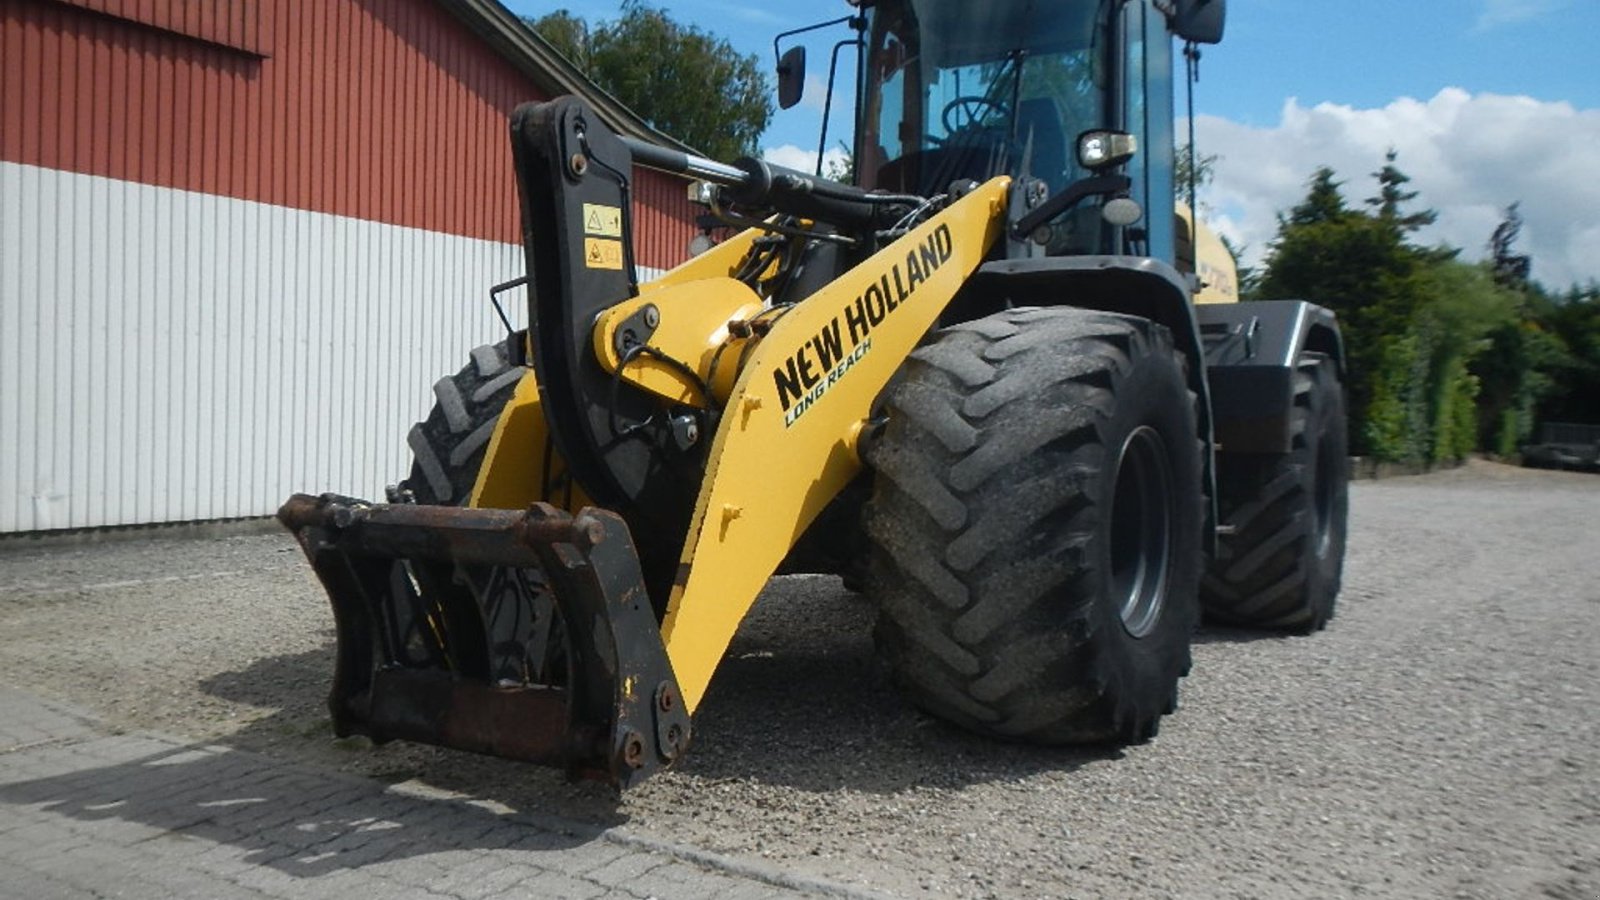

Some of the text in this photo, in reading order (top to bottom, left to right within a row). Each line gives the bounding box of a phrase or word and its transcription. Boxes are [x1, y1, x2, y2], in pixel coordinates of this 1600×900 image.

[773, 223, 952, 412] NEW HOLLAND
[785, 339, 872, 428] LONG REACH
